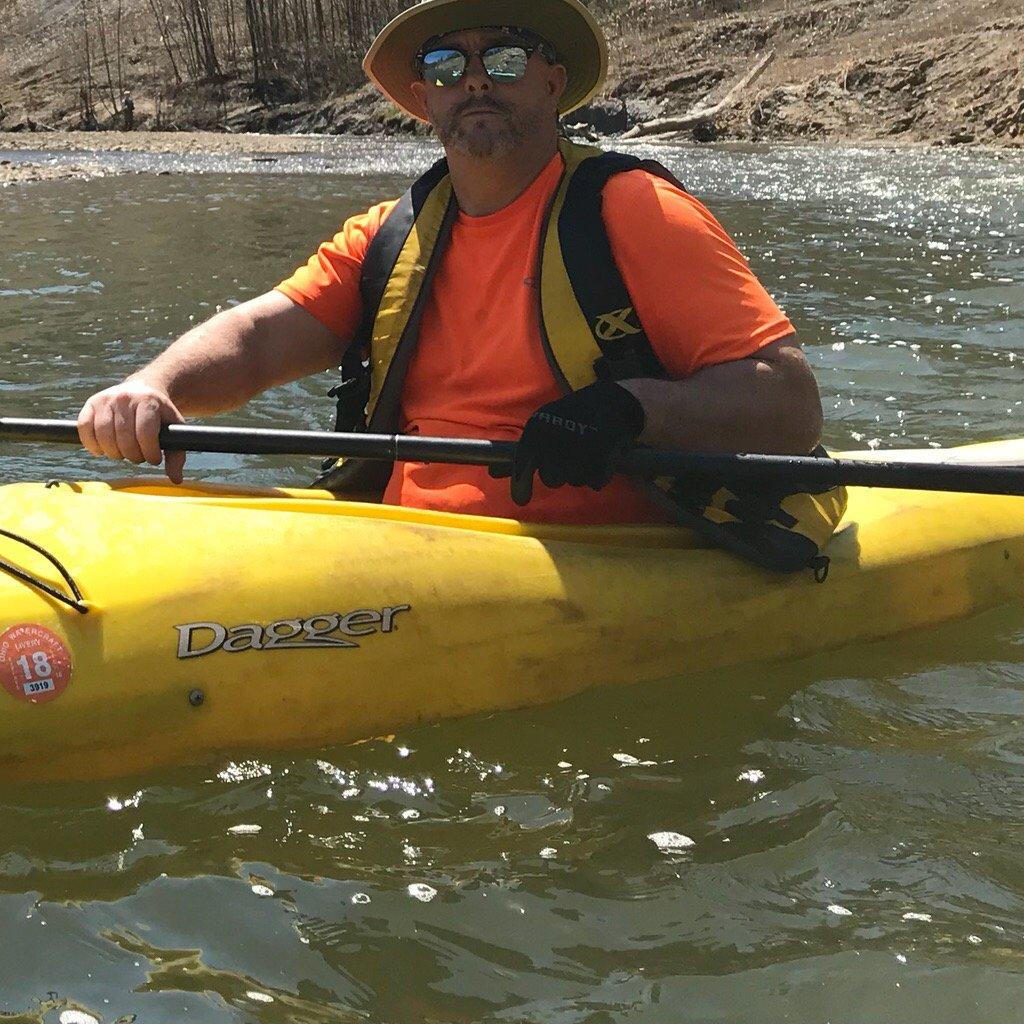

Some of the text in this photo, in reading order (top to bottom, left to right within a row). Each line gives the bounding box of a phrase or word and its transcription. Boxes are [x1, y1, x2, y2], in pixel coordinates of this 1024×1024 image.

[8, 627, 63, 652] WATERCRAFT
[15, 638, 41, 651] LIVERY
[174, 604, 412, 660] Dagger
[16, 651, 52, 680] 18
